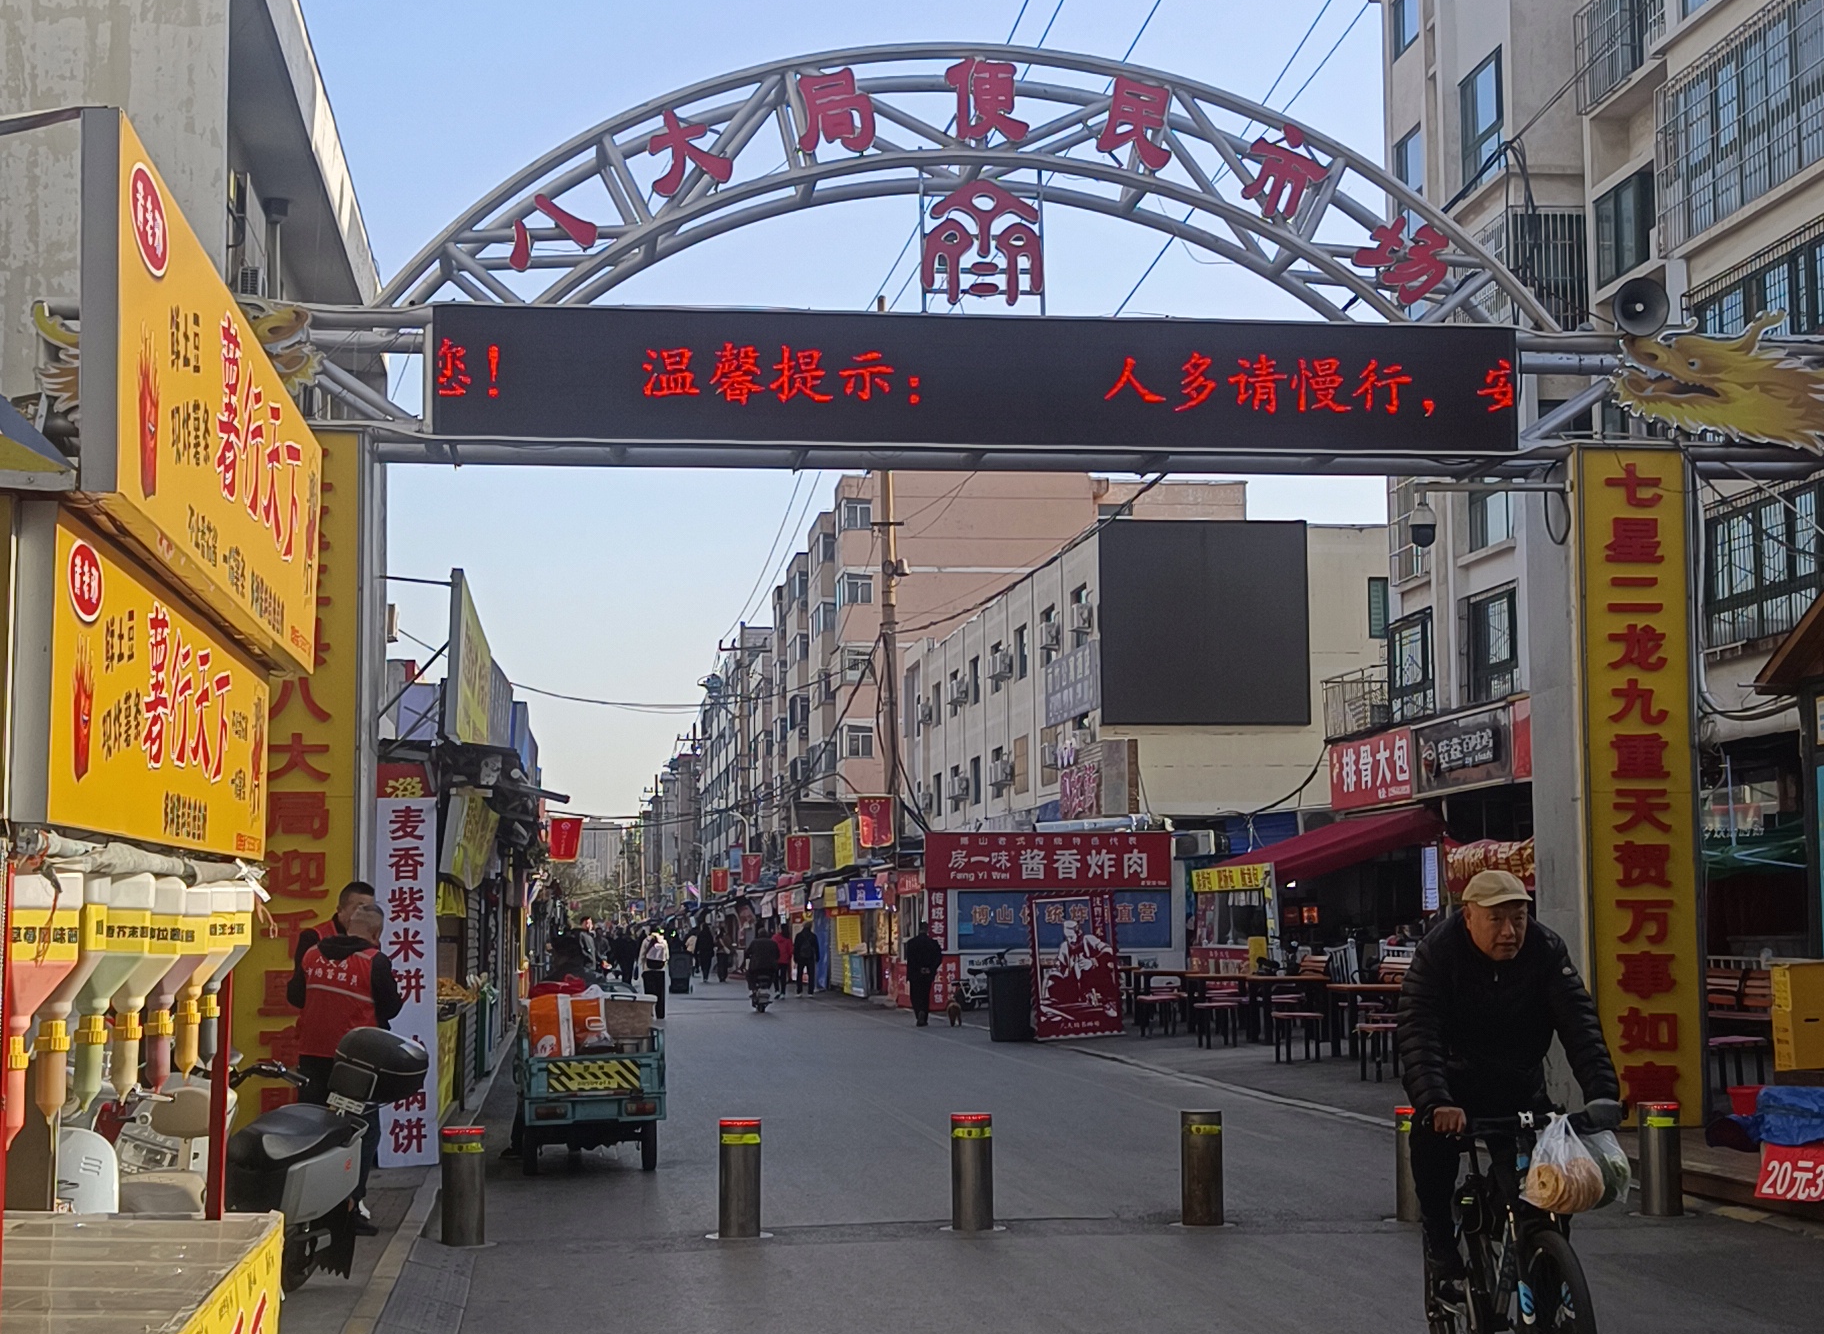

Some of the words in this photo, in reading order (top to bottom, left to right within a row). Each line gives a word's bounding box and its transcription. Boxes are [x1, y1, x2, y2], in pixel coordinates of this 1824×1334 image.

[510, 56, 1454, 305] 八大局便民市场
[170, 304, 200, 373] 鲜土豆
[642, 342, 921, 406] 温馨提示：
[170, 399, 210, 467] 现炸薯条
[215, 309, 302, 563] 薯行天下
[105, 610, 135, 674] 鲜土豆
[102, 688, 141, 761] 现炸薯条
[142, 601, 231, 784] 薯行天下
[1342, 735, 1410, 793] 排骨大包
[1604, 463, 1680, 1104] 七星二龙九重天贺万事如意
[948, 850, 1011, 870] 房一味
[1019, 849, 1148, 880] 酱香炸肉
[950, 871, 975, 882] Fang
[992, 871, 1011, 880] Wei
[388, 806, 426, 1004] 麦香紫米饼
